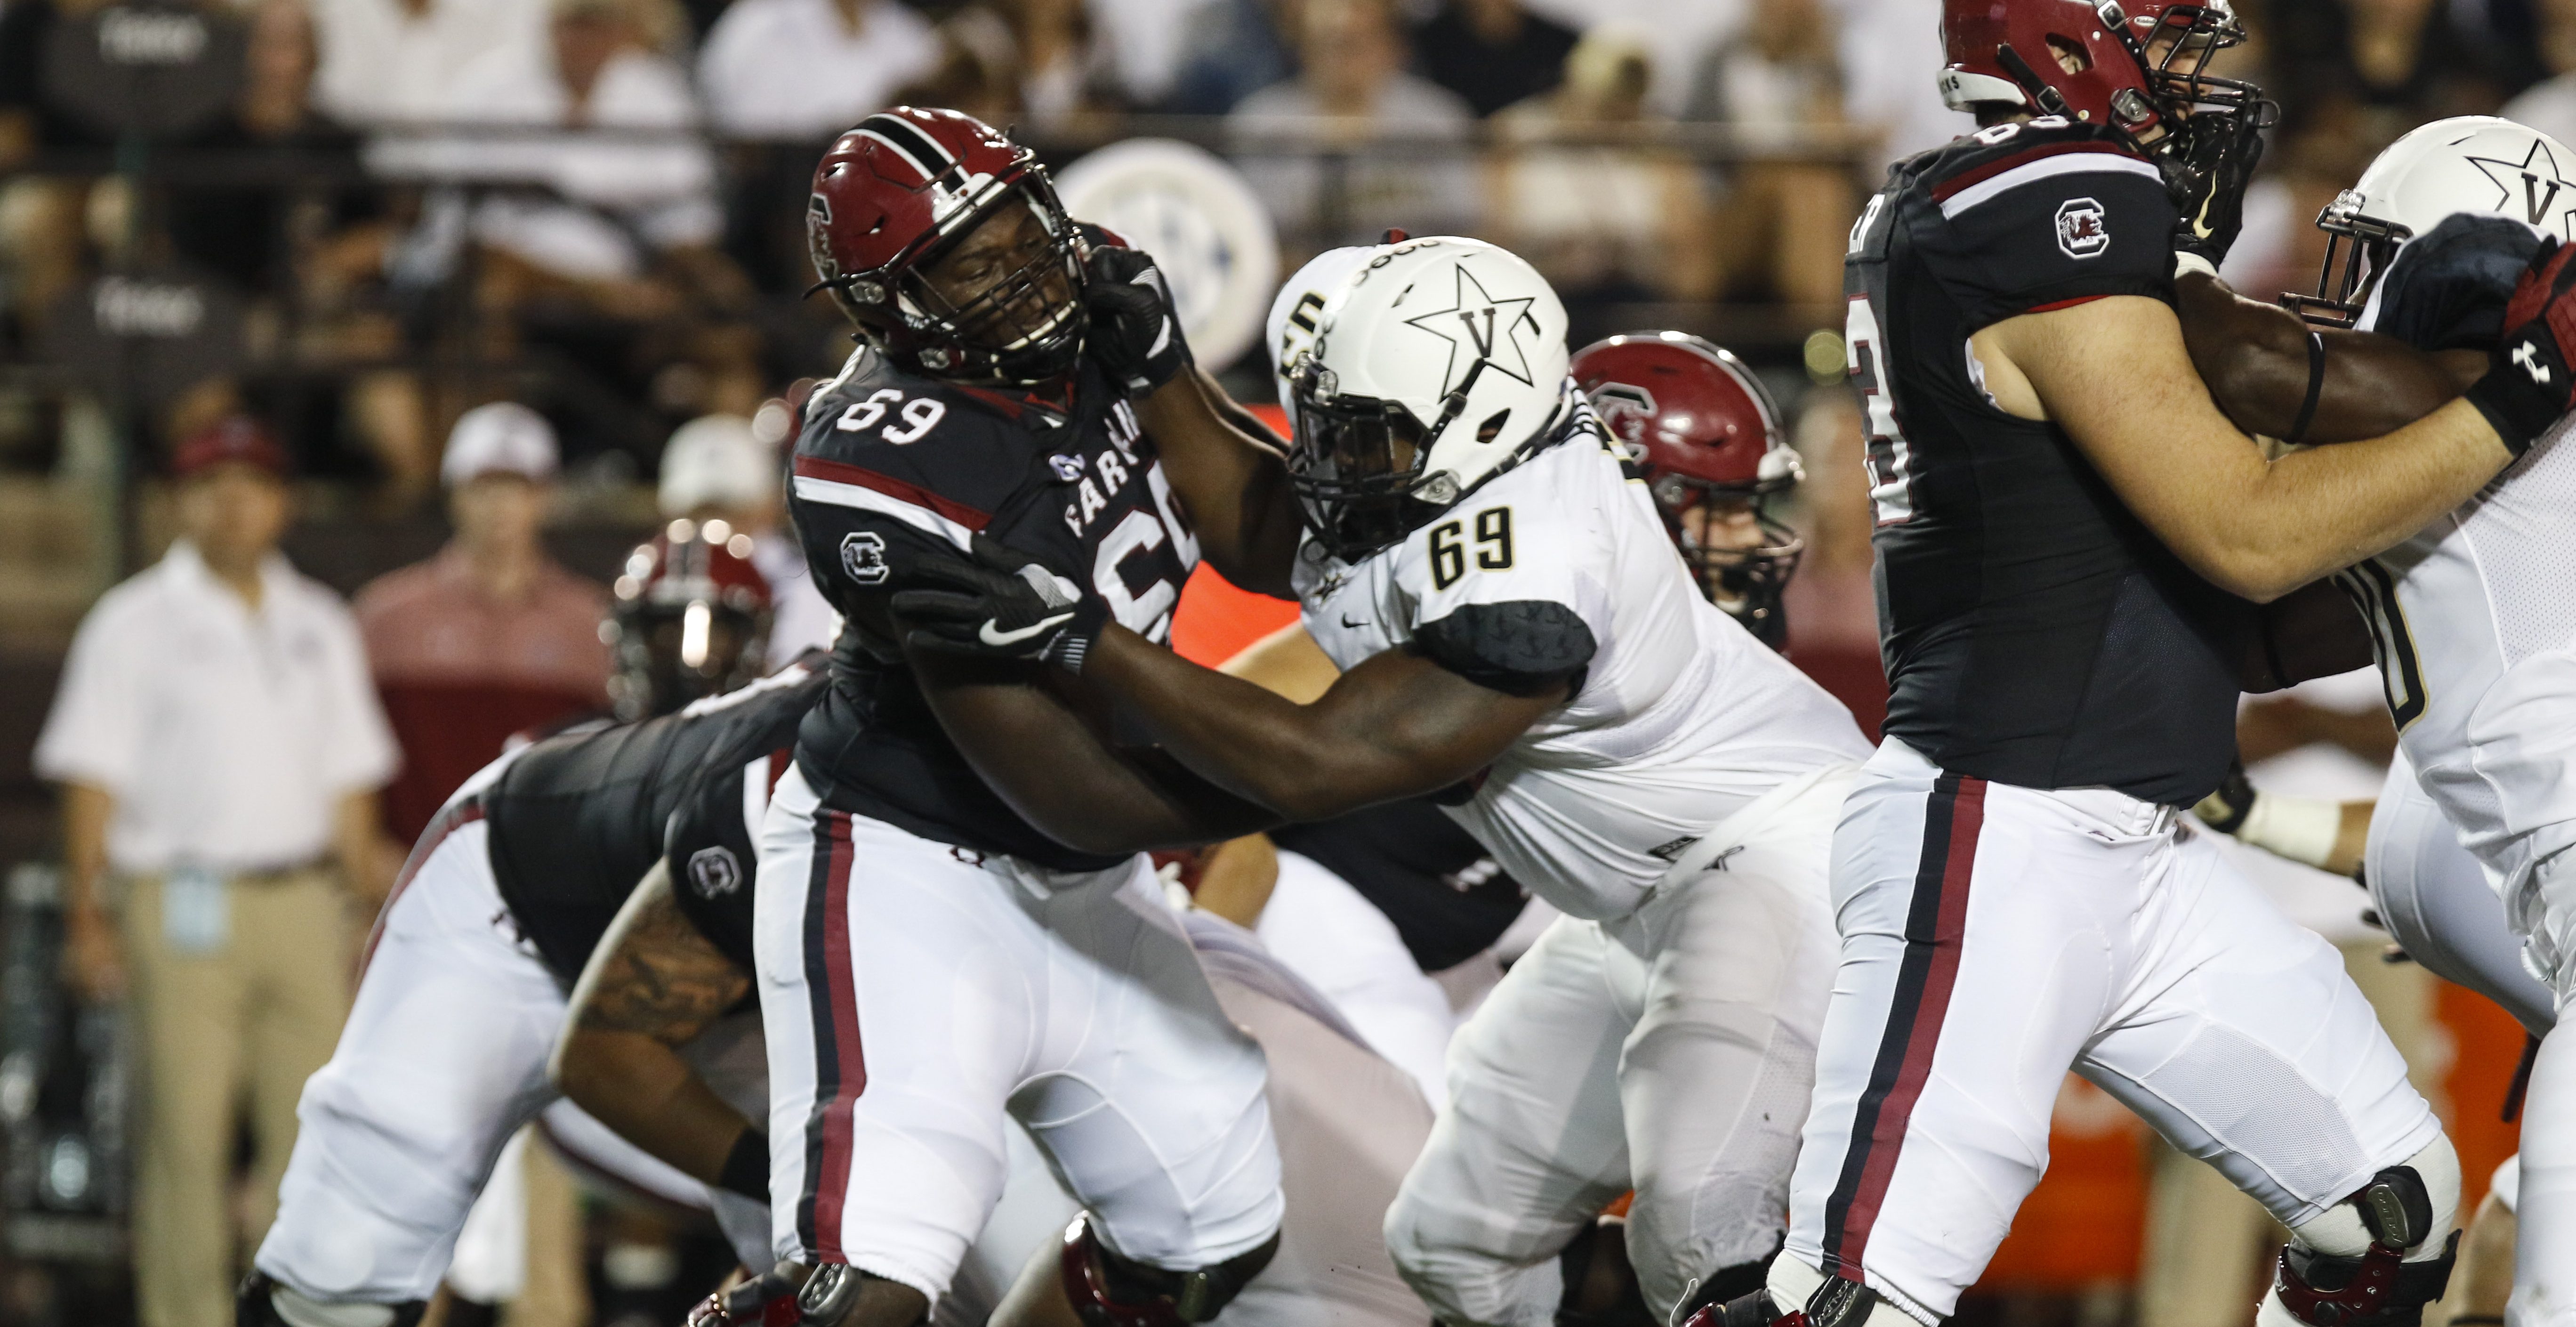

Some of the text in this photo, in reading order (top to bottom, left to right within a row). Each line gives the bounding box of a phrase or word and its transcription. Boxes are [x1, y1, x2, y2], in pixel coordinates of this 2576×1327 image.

[2520, 171, 2560, 226] V
[1458, 307, 1496, 358] V
[836, 388, 947, 445] 69
[1427, 504, 1516, 595] 69
